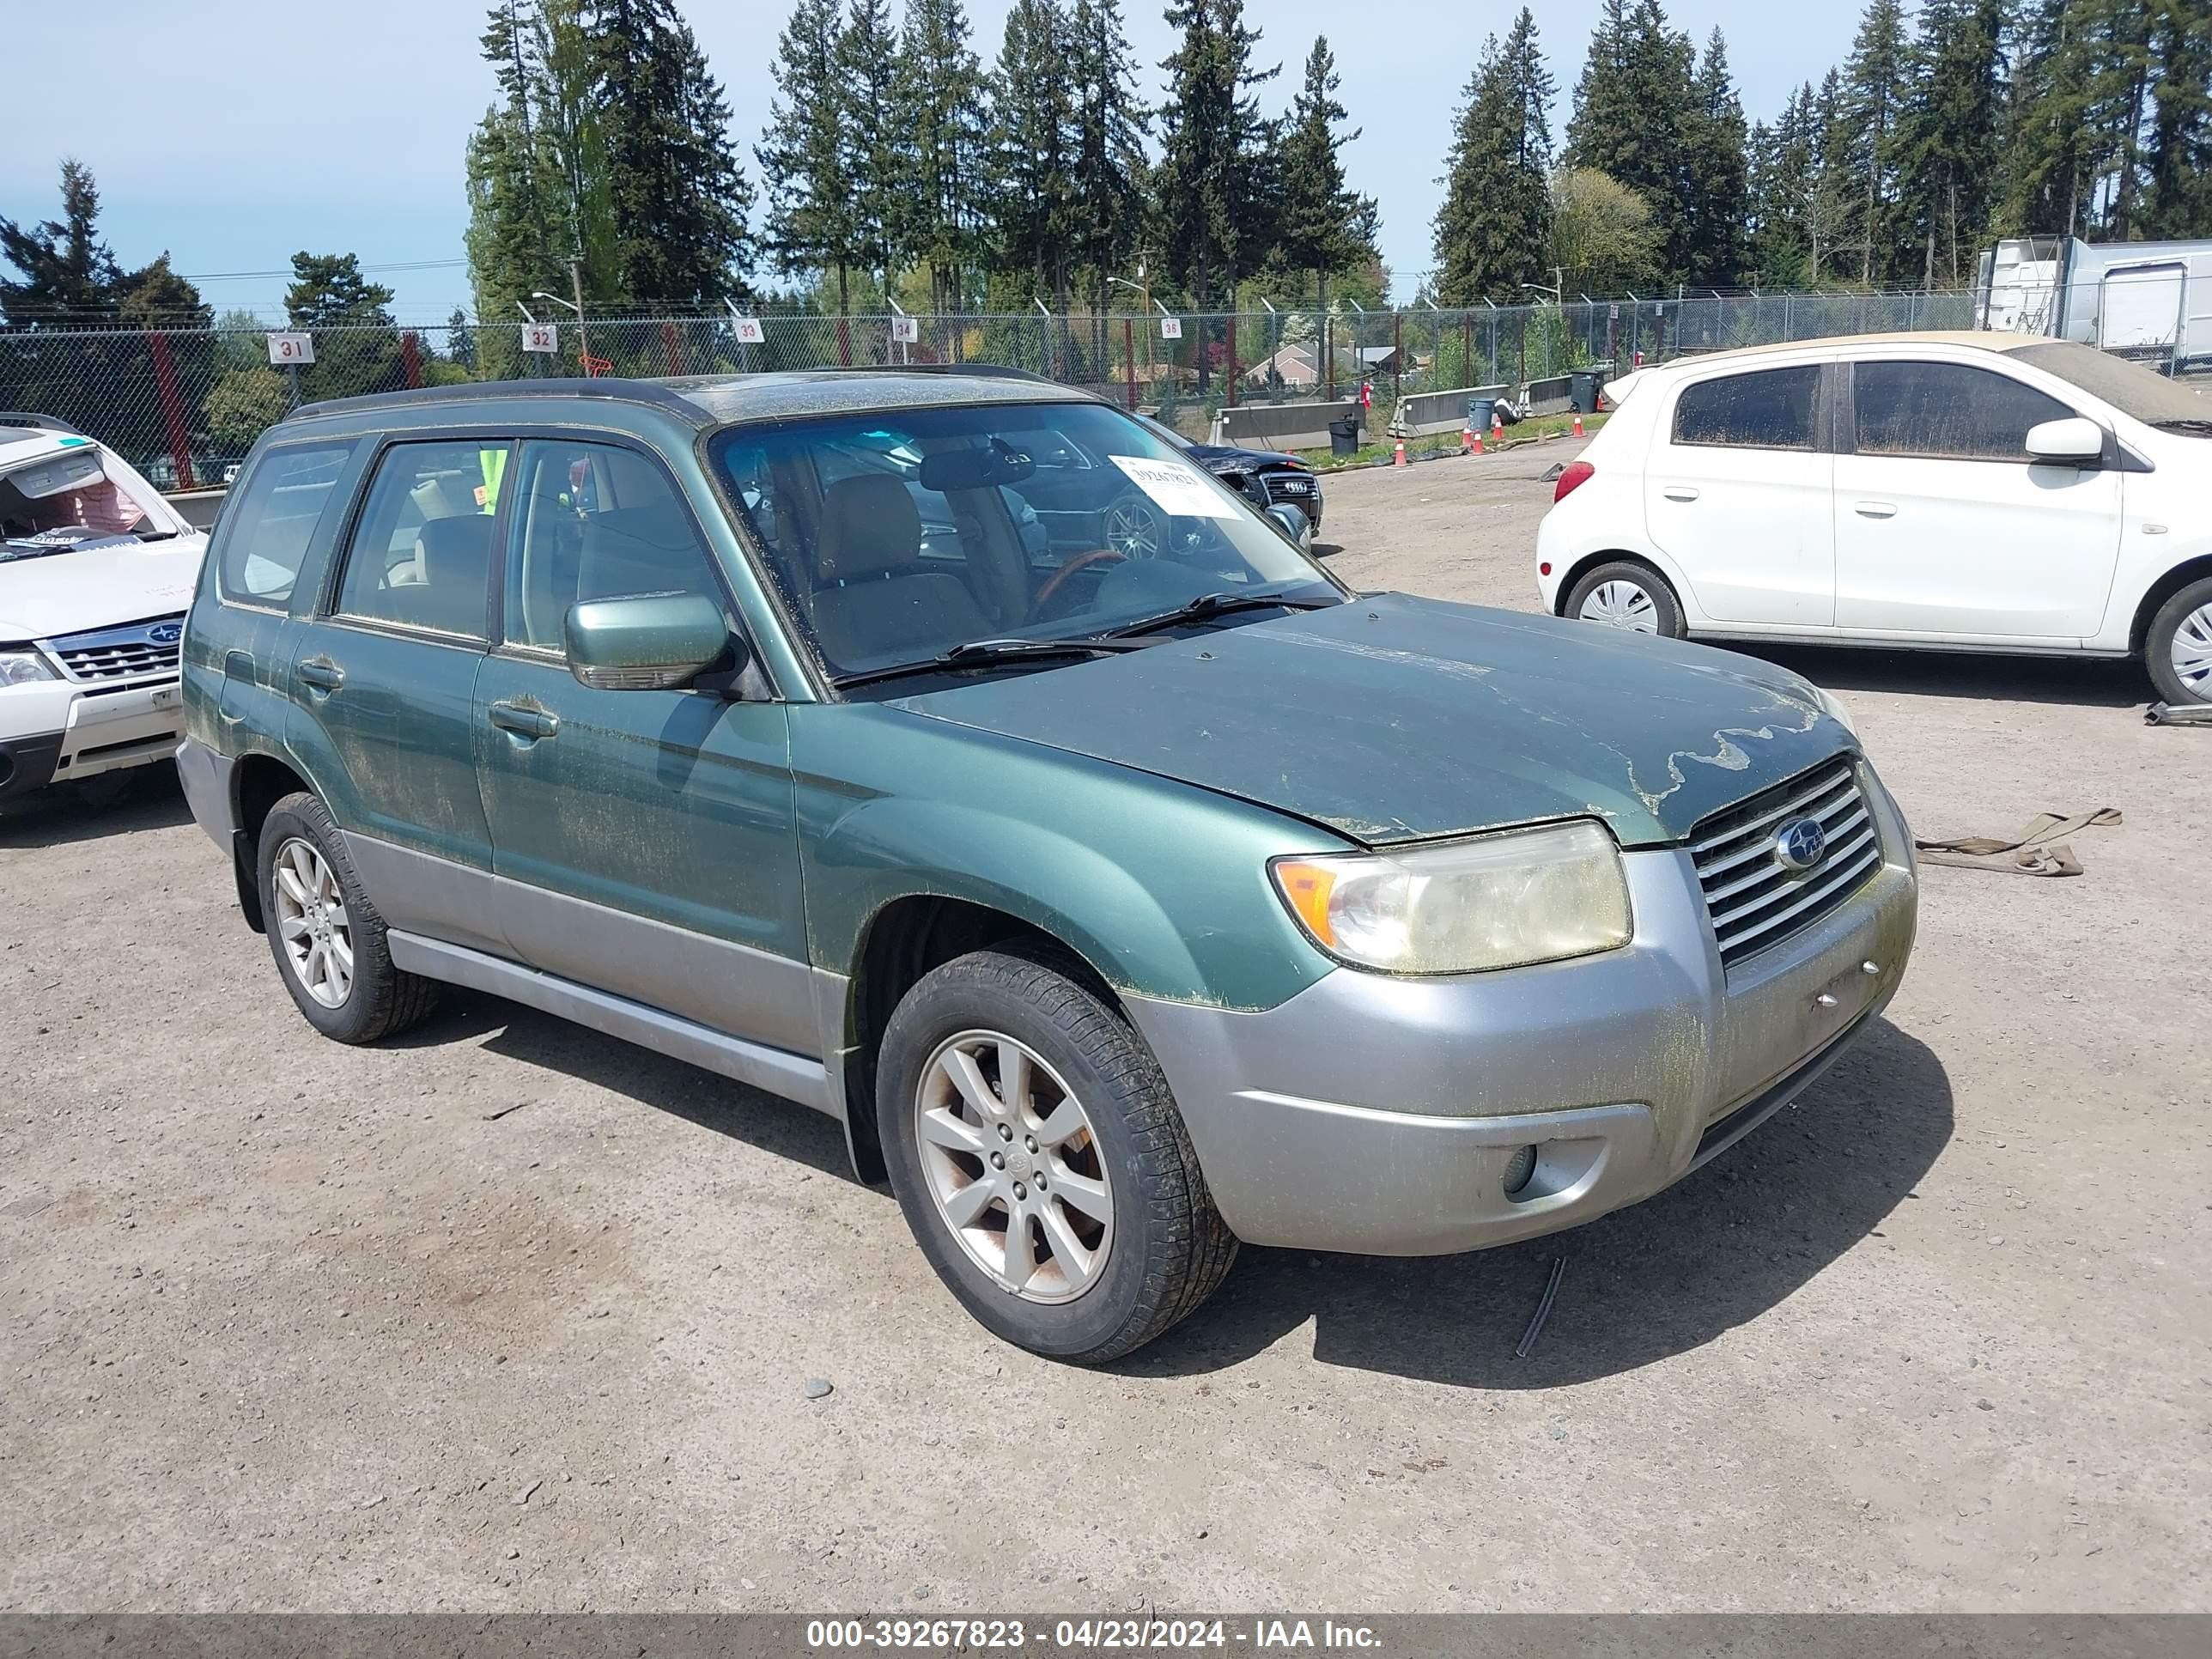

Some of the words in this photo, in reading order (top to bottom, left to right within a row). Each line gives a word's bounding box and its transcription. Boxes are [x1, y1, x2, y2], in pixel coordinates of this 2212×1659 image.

[741, 325, 756, 337] 33
[898, 325, 910, 337] 34
[532, 331, 550, 345] 32
[281, 341, 302, 356] 31
